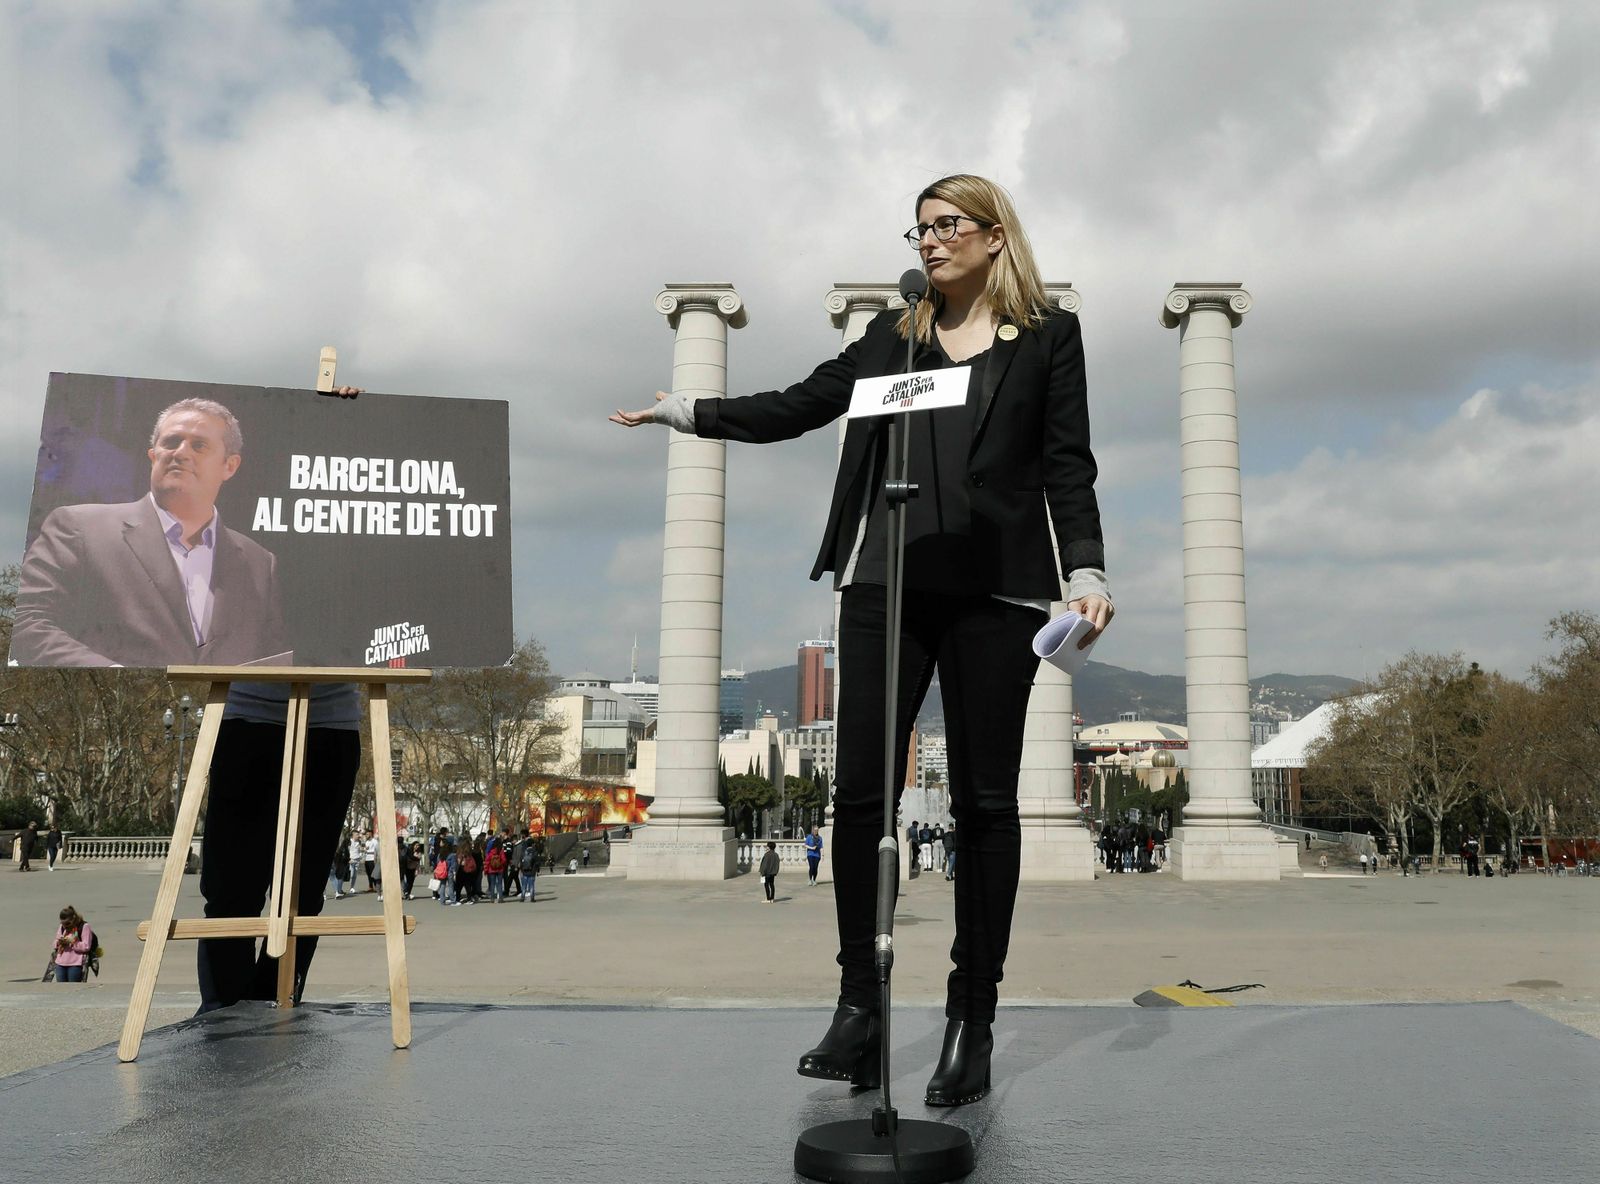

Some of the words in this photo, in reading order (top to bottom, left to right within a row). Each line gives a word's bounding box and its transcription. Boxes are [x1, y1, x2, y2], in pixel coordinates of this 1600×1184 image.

[882, 381, 935, 405] CATALUNYA
[889, 376, 921, 394] JUNTS
[921, 376, 933, 385] PER
[290, 454, 465, 500] BARCELONA,
[252, 497, 288, 532] AL
[293, 498, 401, 535] CENTRE
[406, 502, 441, 536] DE
[445, 503, 497, 537] TOT
[370, 621, 410, 647] JUNTS
[410, 624, 425, 638] PER
[365, 634, 430, 665] CATALUNYA
